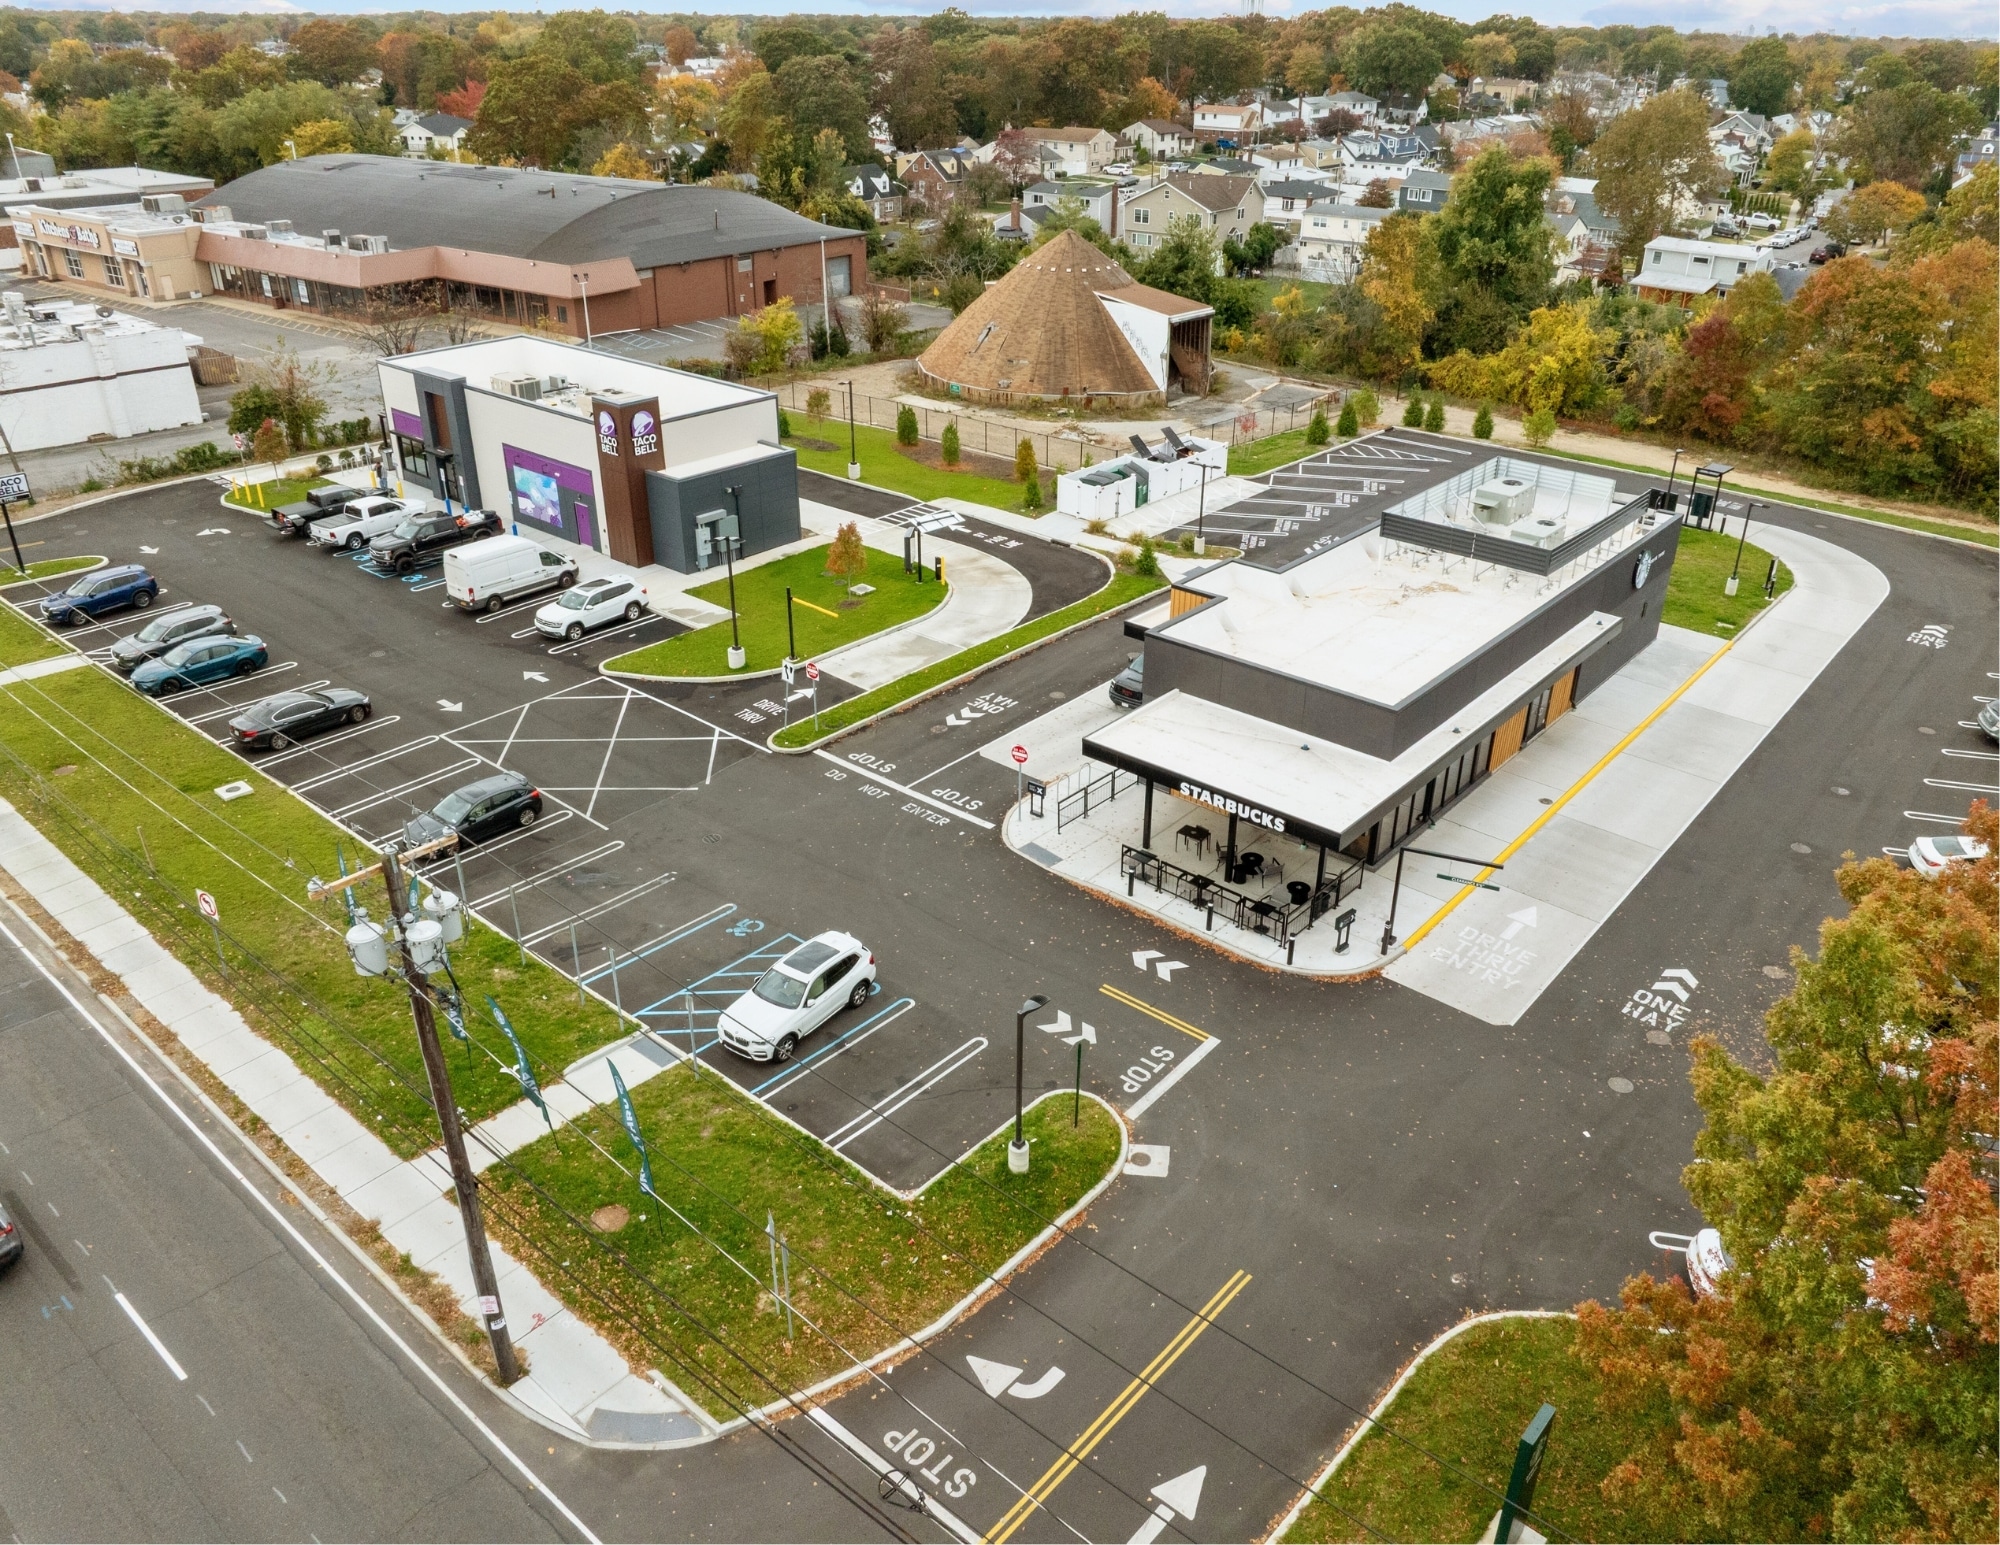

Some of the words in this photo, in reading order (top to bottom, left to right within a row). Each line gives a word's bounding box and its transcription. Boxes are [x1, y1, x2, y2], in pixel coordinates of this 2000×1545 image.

[599, 434, 617, 447] TACO
[601, 443, 619, 456] BELL
[632, 434, 657, 447] TACO
[634, 443, 658, 456] BELL
[0, 477, 22, 487] ACO
[734, 708, 766, 724] THRU
[753, 699, 788, 716] DRIVE
[966, 697, 1005, 714] ONE
[848, 752, 897, 773] STOP
[824, 768, 847, 781] DO
[857, 784, 890, 799] NOT
[901, 802, 950, 826] ENTER
[931, 788, 983, 811] STOP
[1180, 782, 1285, 832] STARBUCKS
[1456, 939, 1523, 975] THRU
[1458, 926, 1538, 965] DRIVE
[1430, 947, 1521, 989] ENTRY
[1621, 1001, 1682, 1033] WAY
[1632, 989, 1692, 1022] ONE
[1119, 1045, 1175, 1093] STOP
[883, 1428, 977, 1498] STOP
